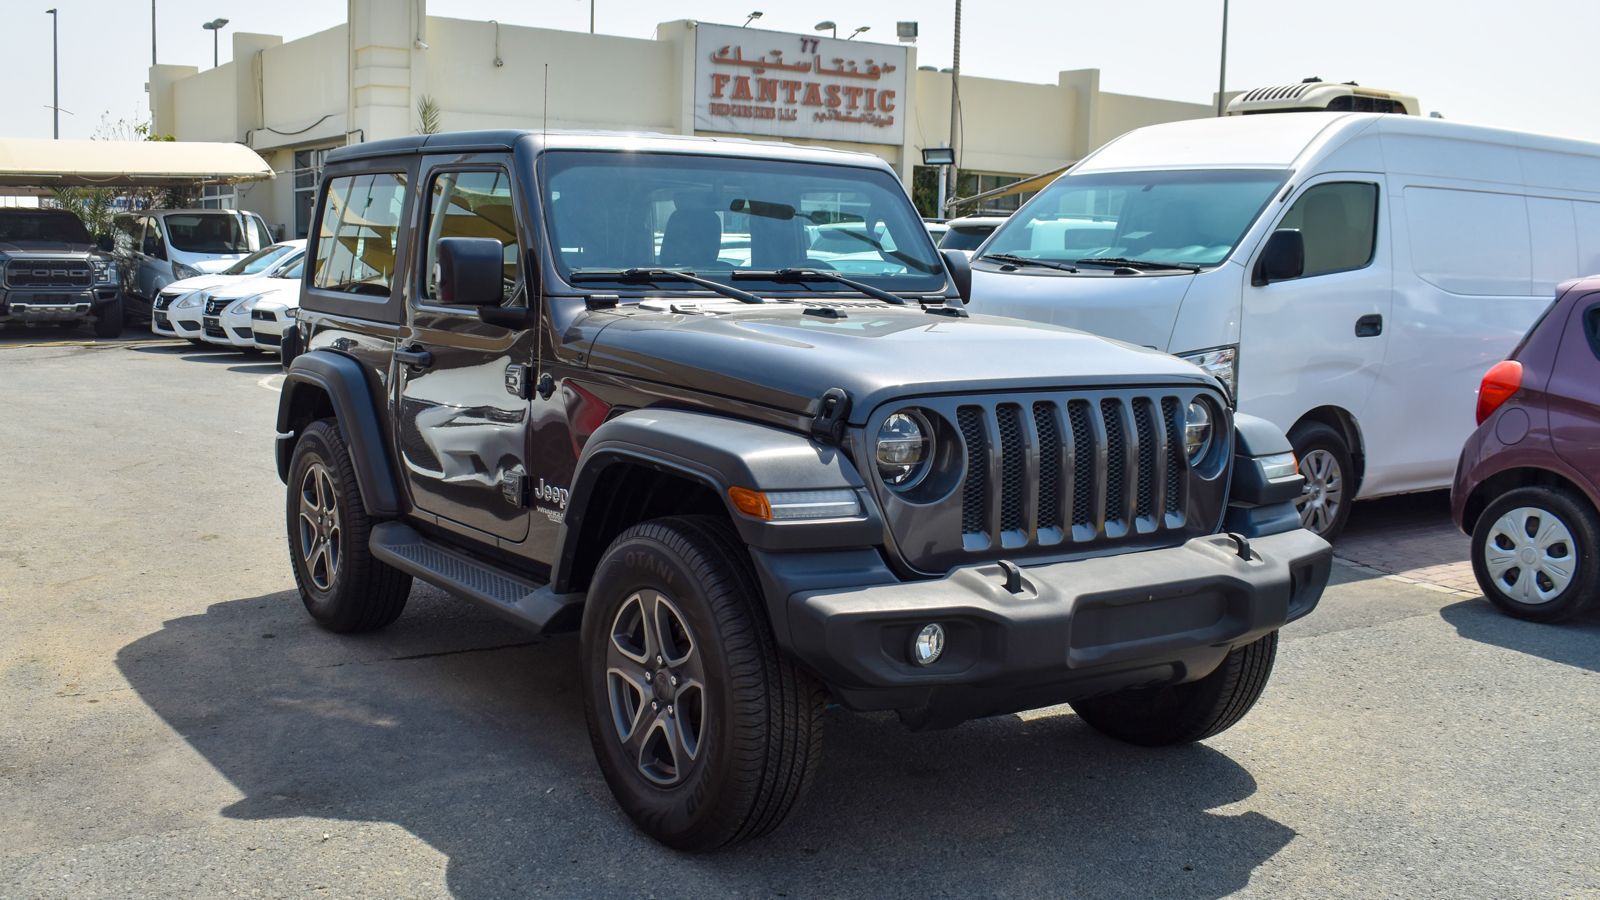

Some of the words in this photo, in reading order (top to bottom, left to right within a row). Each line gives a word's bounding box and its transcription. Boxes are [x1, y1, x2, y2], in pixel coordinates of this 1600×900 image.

[709, 73, 896, 113] FANTASTIC
[7, 269, 88, 277] FORD
[534, 478, 569, 509] Jeep
[624, 551, 676, 585] OTANI
